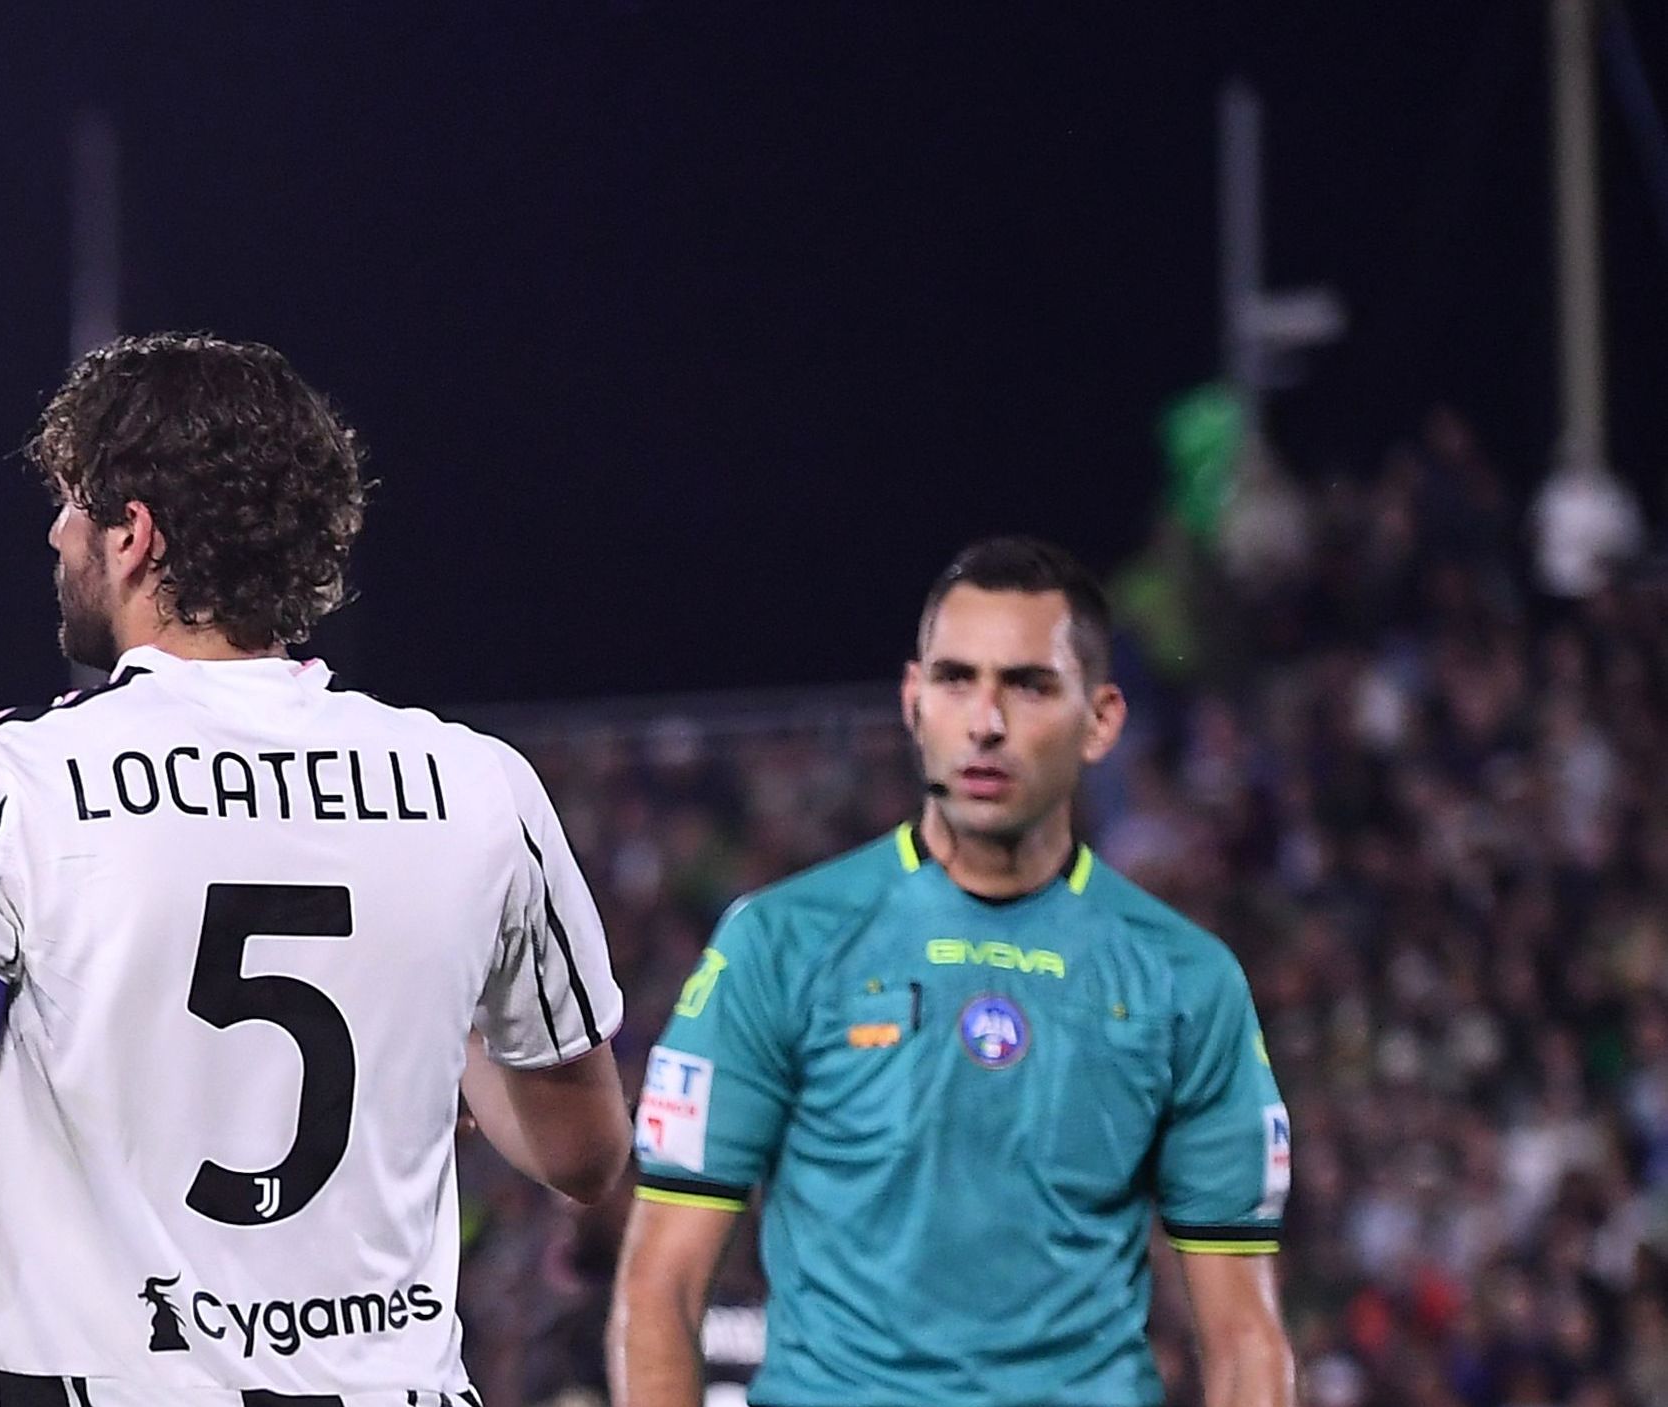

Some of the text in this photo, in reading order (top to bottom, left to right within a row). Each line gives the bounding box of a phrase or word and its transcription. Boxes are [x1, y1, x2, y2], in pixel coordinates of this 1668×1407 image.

[67, 746, 448, 822] LOCATELLI
[184, 882, 356, 1227] 5
[192, 1283, 443, 1359] Cygames
